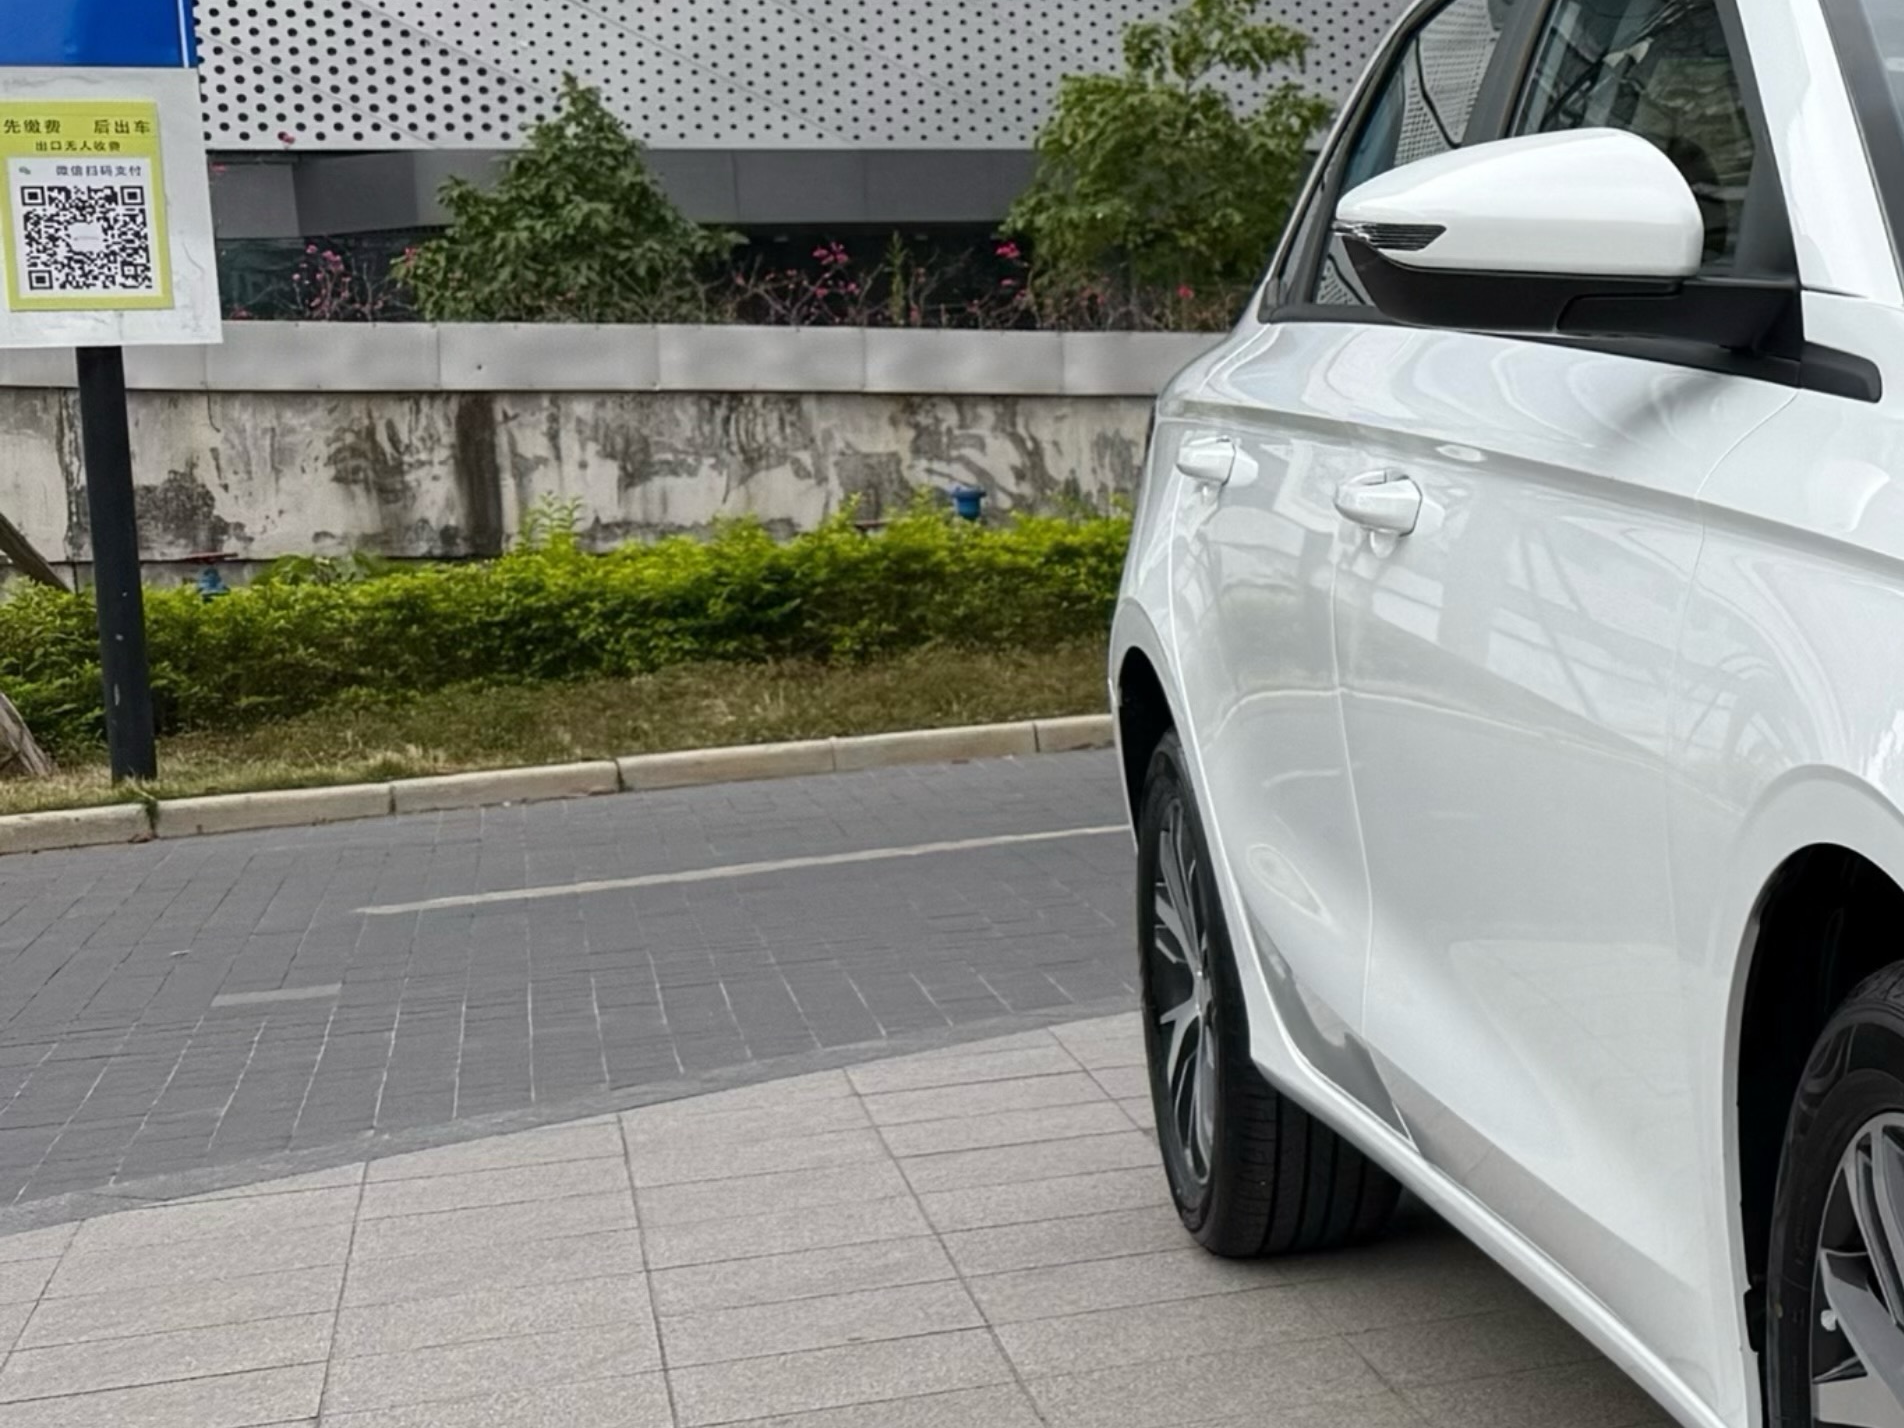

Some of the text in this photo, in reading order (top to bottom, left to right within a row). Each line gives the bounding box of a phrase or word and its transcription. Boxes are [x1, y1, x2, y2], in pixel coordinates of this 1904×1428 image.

[3, 119, 151, 134] 先缴费 后出车
[35, 140, 121, 152] 出口无人收费
[55, 165, 142, 177] 微信扫码支付
